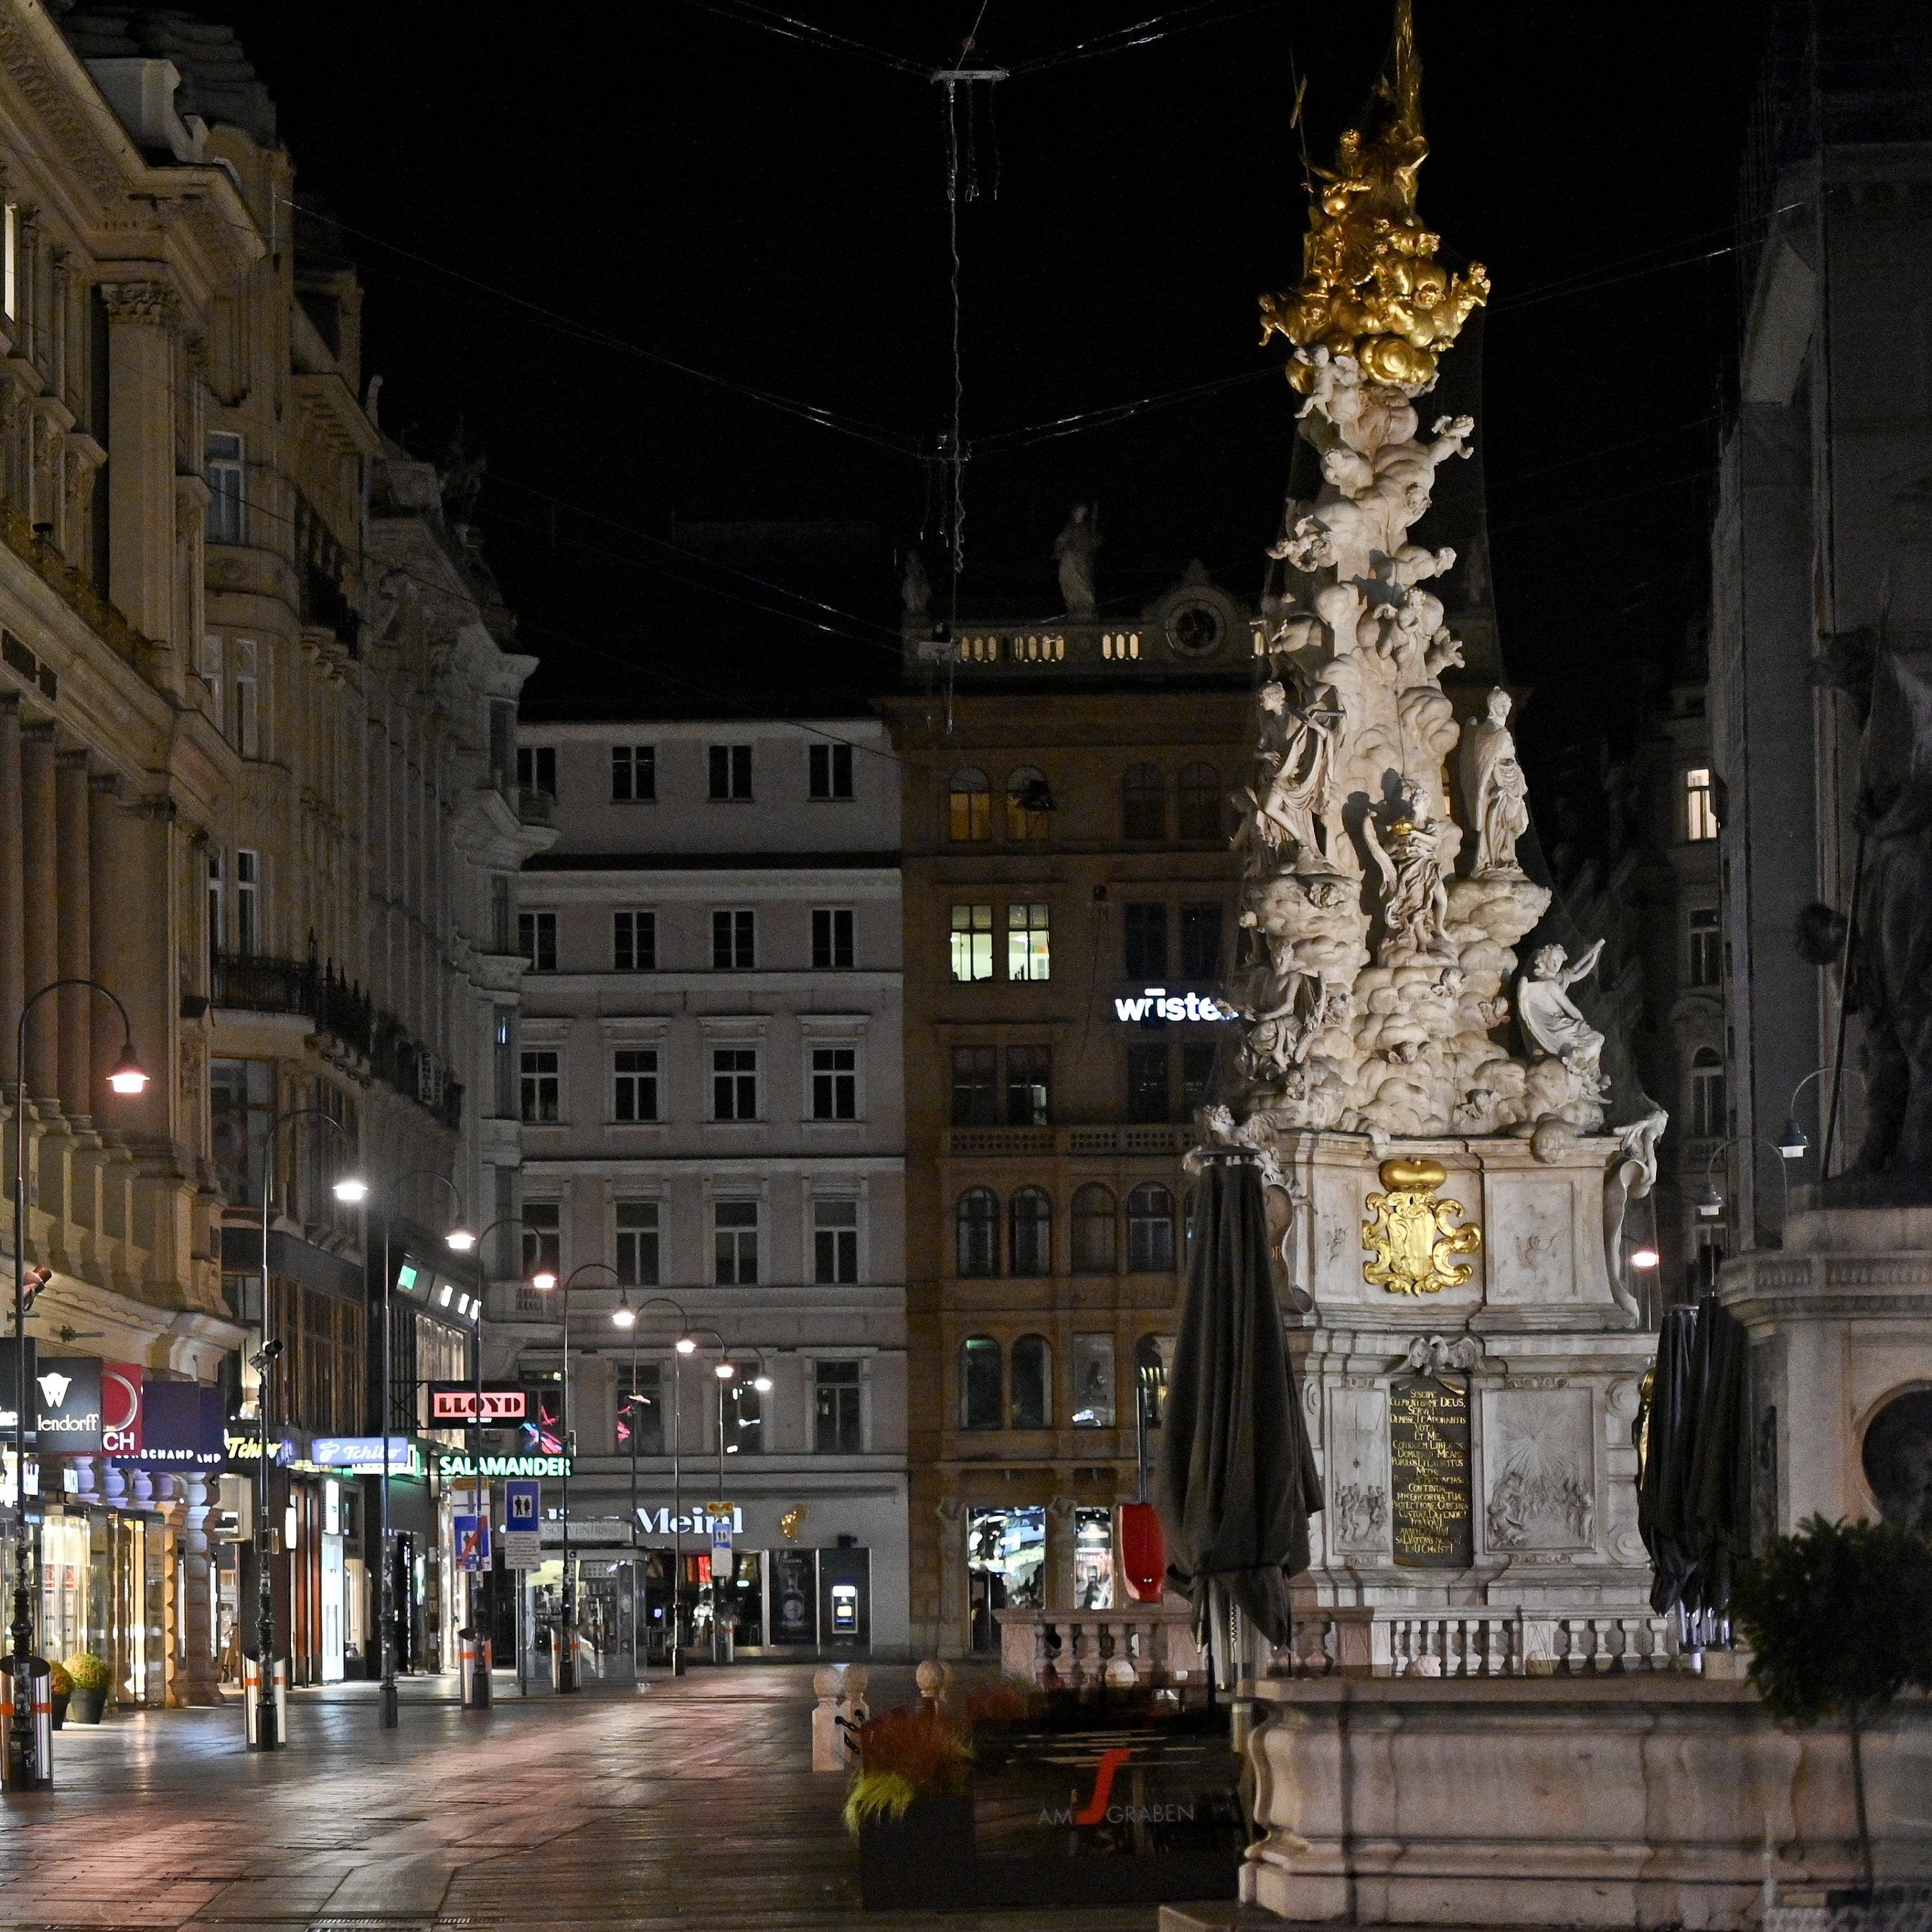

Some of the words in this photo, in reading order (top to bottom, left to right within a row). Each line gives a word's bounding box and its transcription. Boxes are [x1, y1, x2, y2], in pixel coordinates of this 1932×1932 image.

[439, 1397, 521, 1413] LLOYD
[37, 1413, 100, 1431] lendorff
[103, 1432, 135, 1451] CH
[228, 1437, 281, 1459] Tchio
[440, 1456, 571, 1476] SALAMANDER
[634, 1507, 744, 1534] Meinl
[1040, 1808, 1073, 1825] AM
[1106, 1804, 1194, 1824] GRABEN
